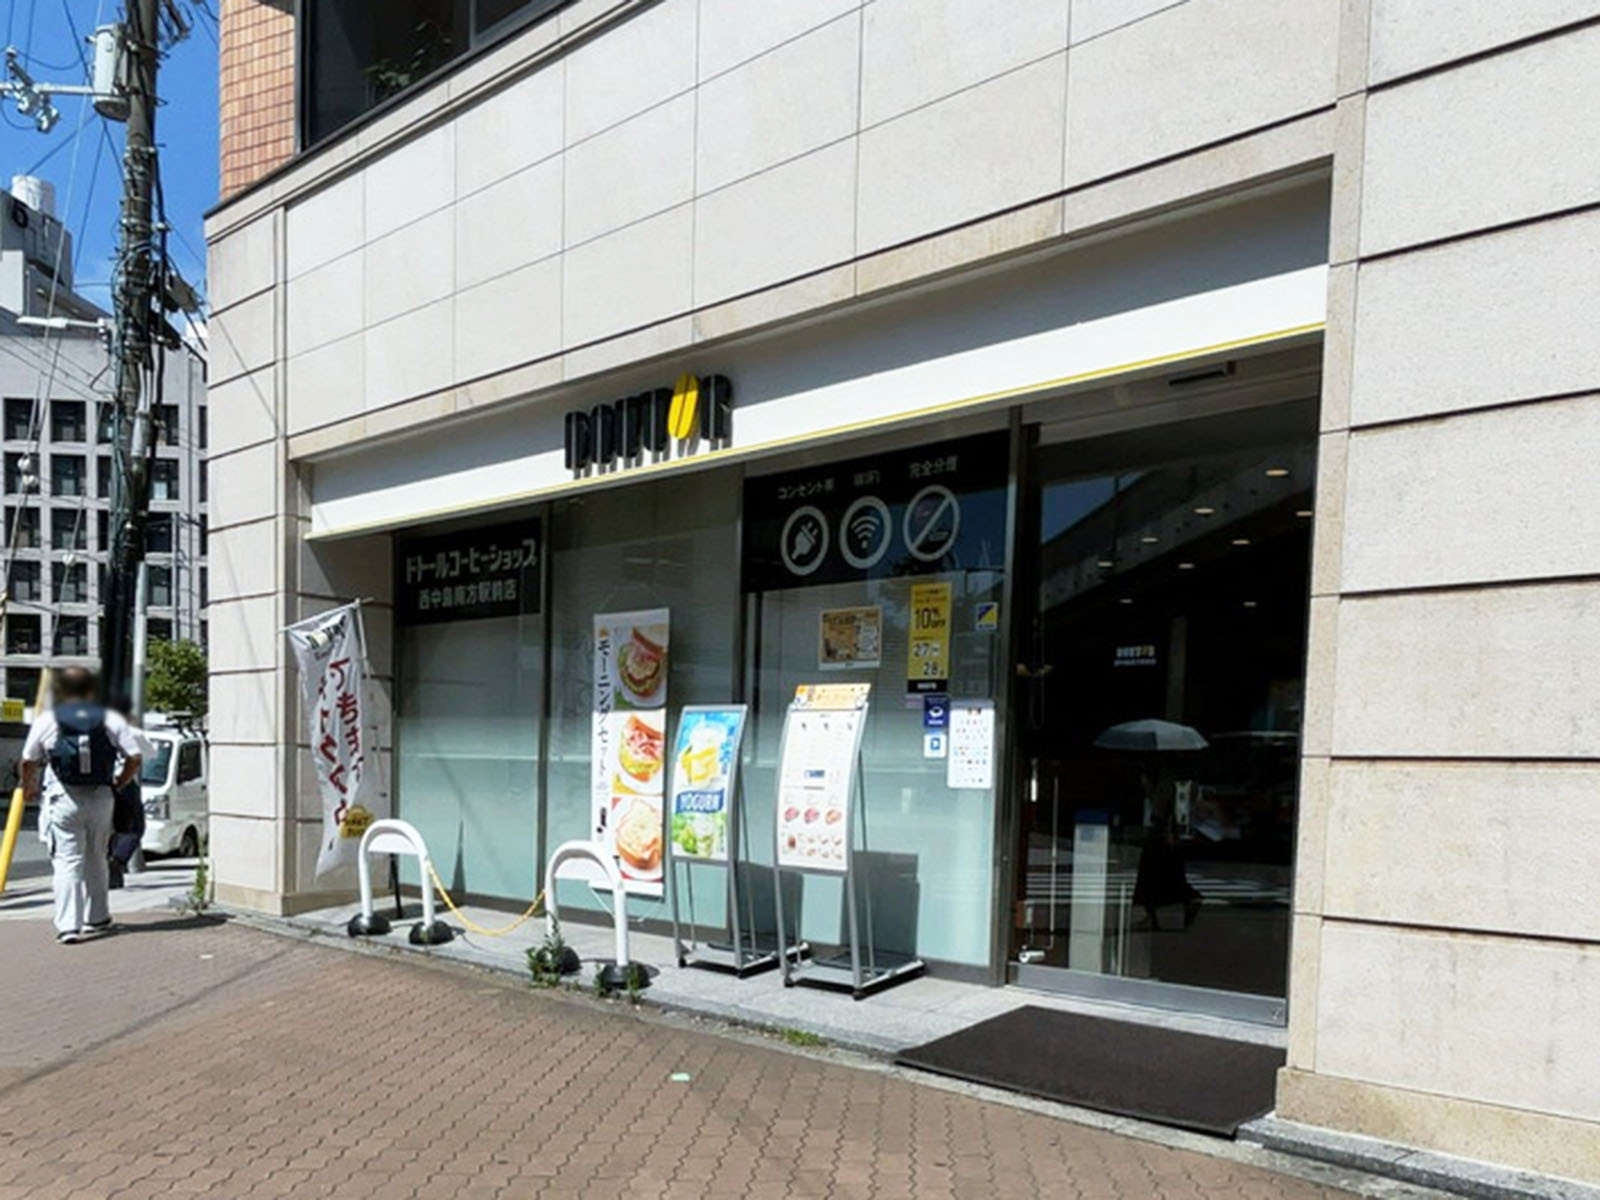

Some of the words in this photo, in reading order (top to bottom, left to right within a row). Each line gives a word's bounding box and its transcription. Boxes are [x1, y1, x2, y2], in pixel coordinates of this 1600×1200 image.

[406, 538, 538, 584] ドトールコーヒーショップ
